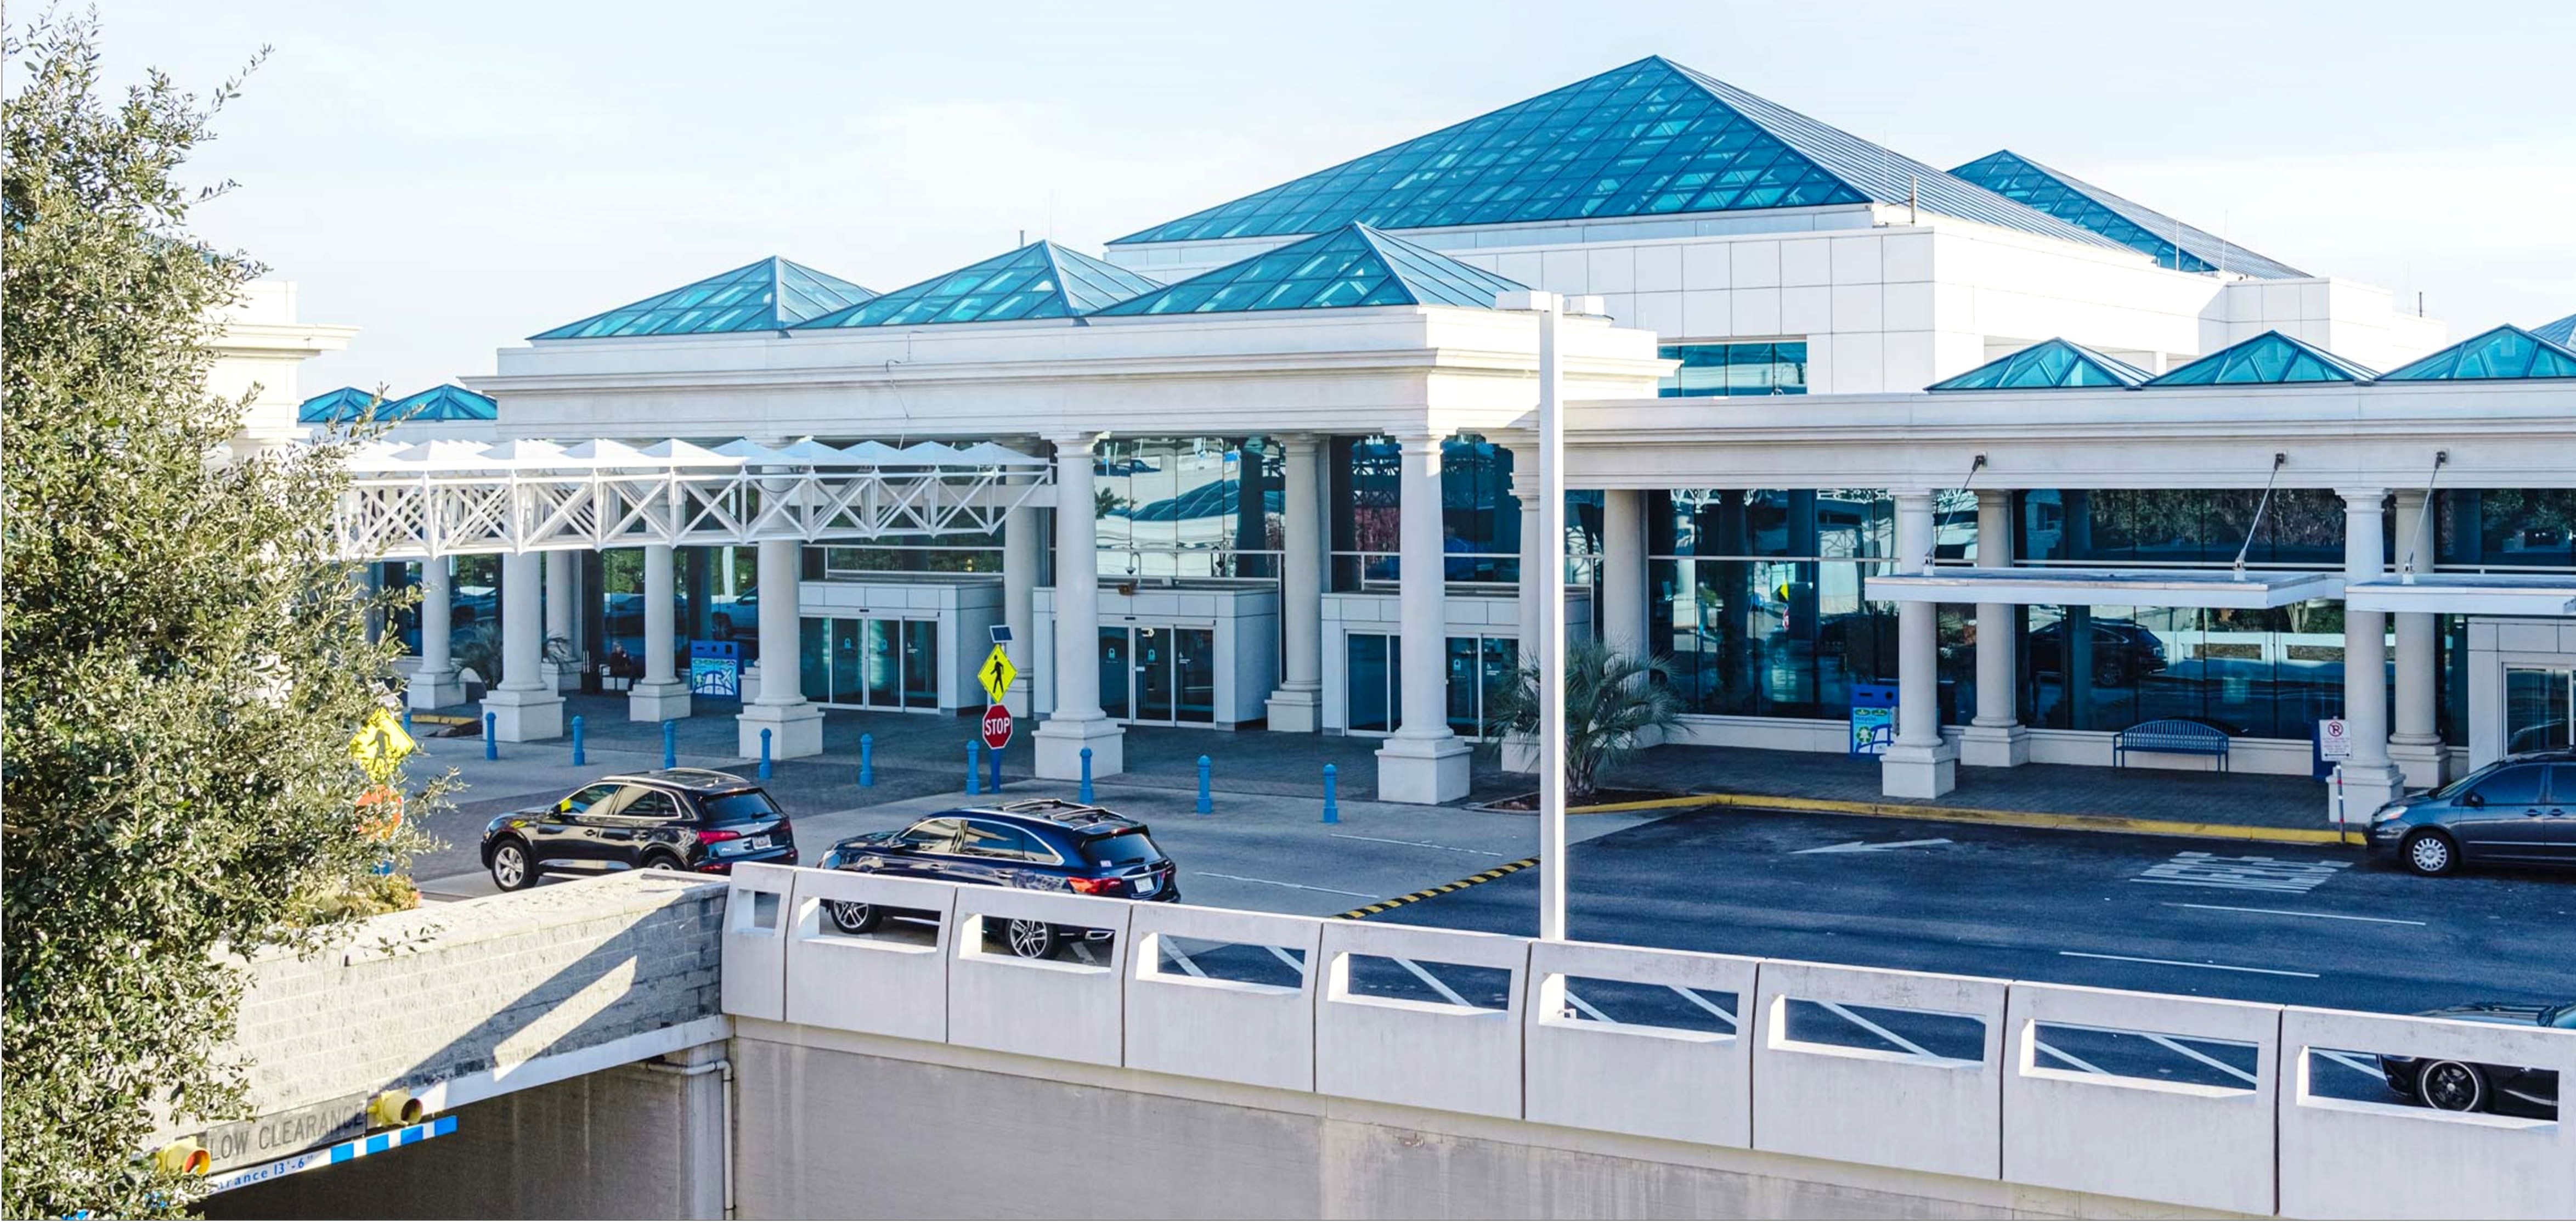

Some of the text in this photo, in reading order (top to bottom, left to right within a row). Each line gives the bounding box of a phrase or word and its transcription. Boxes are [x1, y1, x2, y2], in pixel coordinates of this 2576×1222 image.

[985, 717, 1010, 735] STOP
[210, 1103, 363, 1161] LOW CLEARANCE
[211, 1170, 268, 1193] arance
